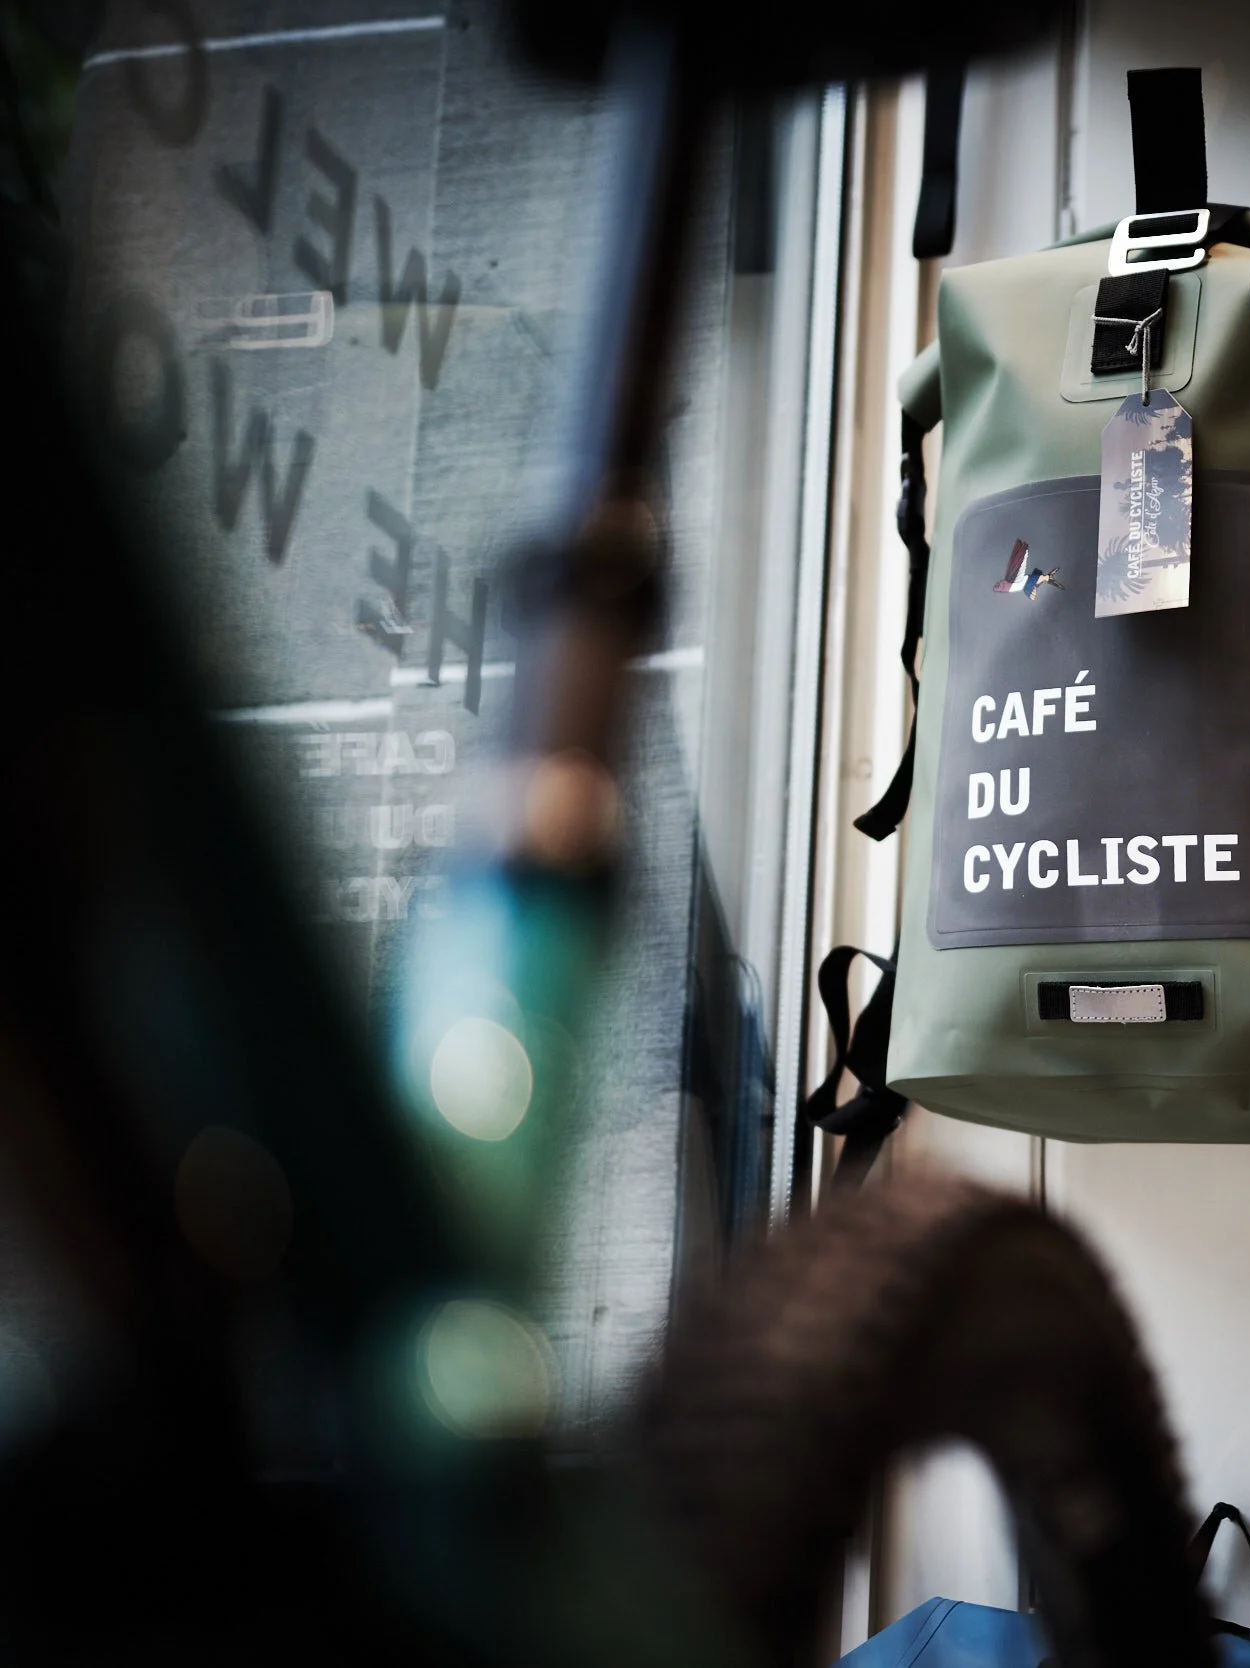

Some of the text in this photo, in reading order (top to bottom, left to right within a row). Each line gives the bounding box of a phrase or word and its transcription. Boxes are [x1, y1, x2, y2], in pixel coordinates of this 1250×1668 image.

[1127, 450, 1143, 578] CAFÉ DU CYCLISTE
[971, 670, 1097, 743] CAFÉ
[967, 767, 1030, 820] DU
[963, 834, 1241, 893] CYCLISTE
